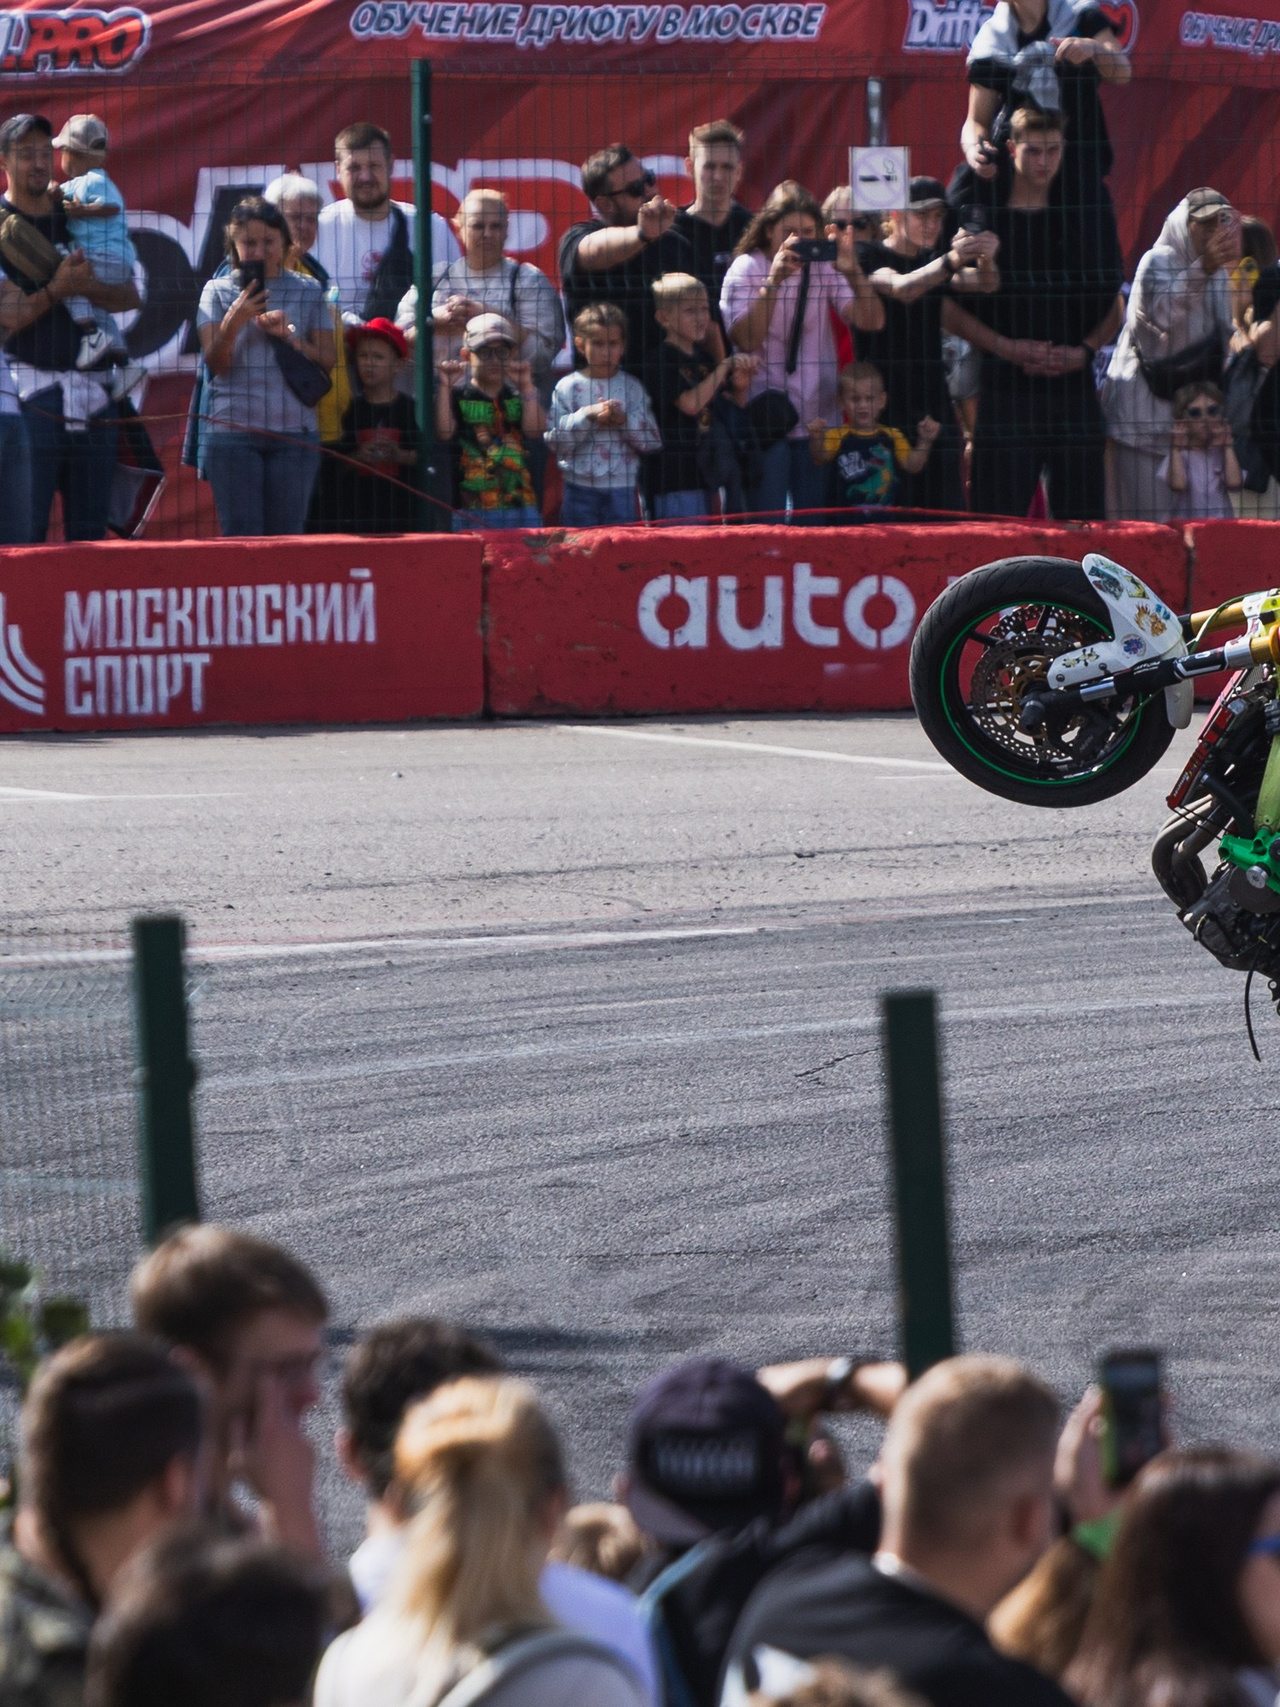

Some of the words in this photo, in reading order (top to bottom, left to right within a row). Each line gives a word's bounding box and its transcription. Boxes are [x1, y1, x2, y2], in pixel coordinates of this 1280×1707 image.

[351, 3, 517, 39] ОБУЧЕНИЕ
[516, 4, 654, 46] ДРИФТУ
[656, 4, 684, 41] В
[684, 4, 824, 40] МОСКВЕ
[63, 567, 377, 652] МОСКОВСКИЙ
[64, 652, 212, 717] СПОРТ
